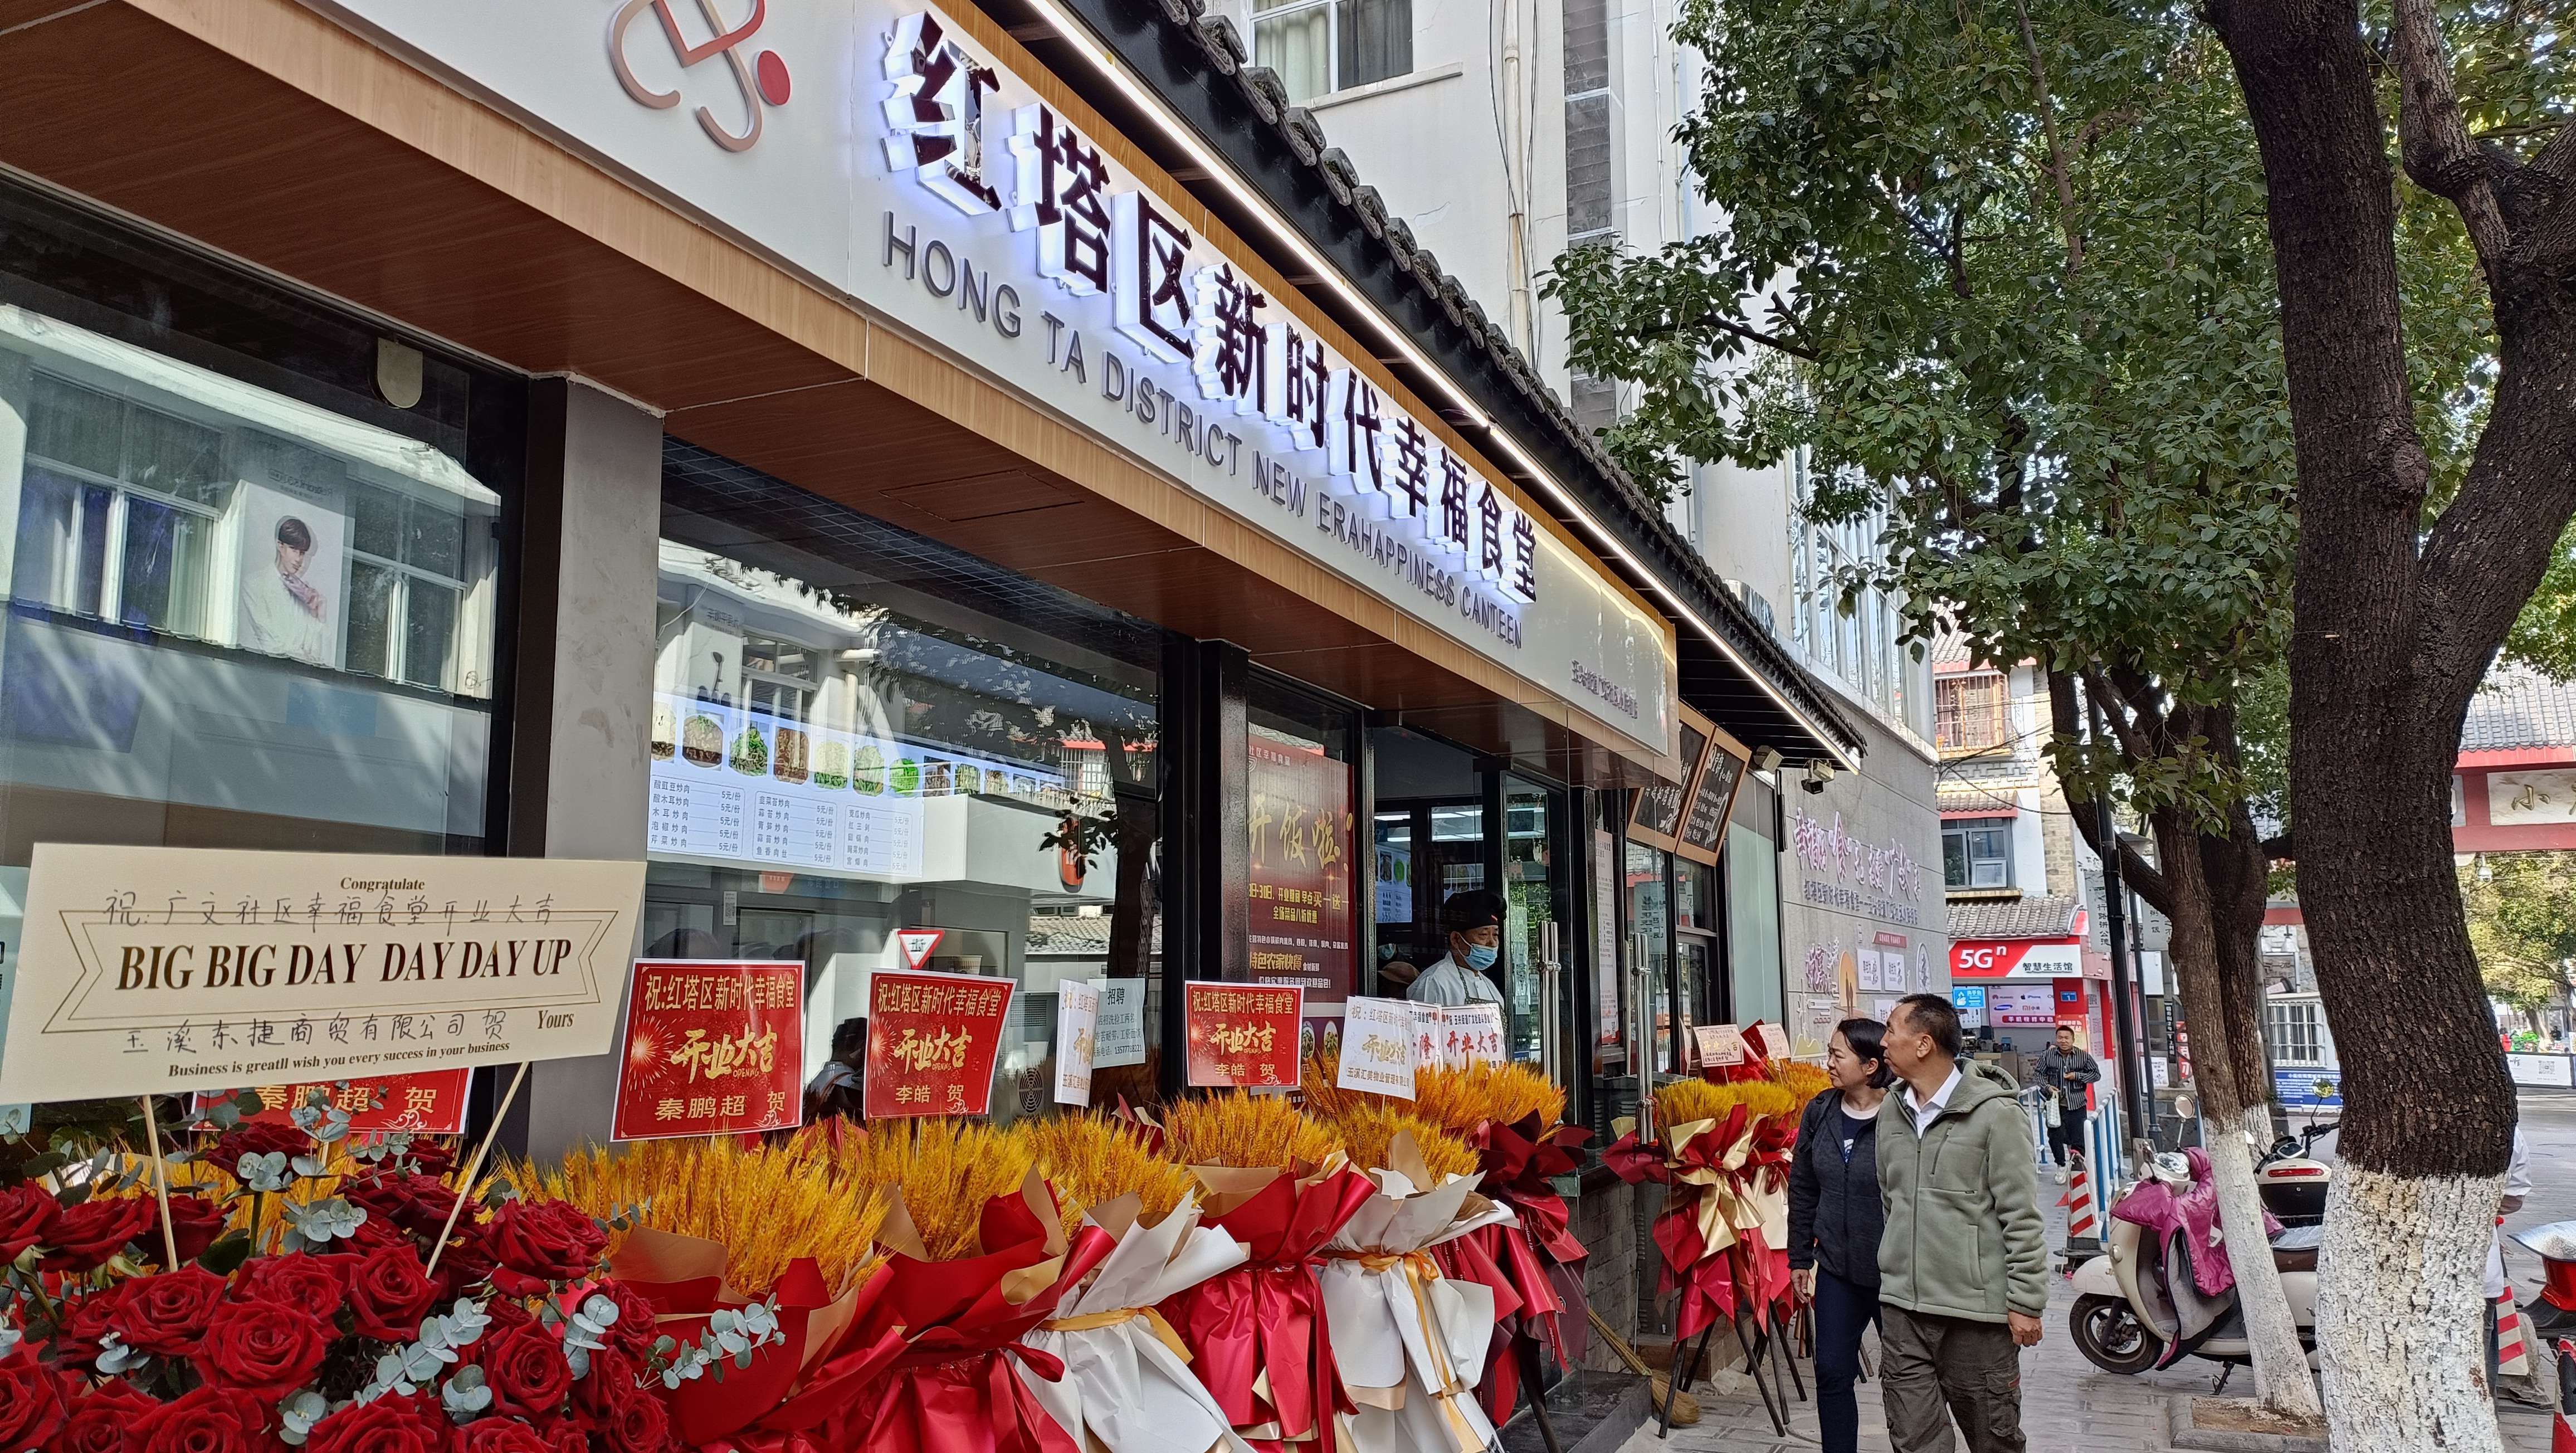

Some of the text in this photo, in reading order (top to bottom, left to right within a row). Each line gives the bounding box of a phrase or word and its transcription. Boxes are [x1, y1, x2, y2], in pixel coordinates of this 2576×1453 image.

[883, 8, 1536, 603] 红塔区新时代幸福食堂
[883, 210, 1523, 650] HONG TA DISTRICT NEW ERAHAPPINESS CANTEEN
[654, 780, 740, 801] 酸豇豆炒肉 5元/份
[653, 793, 740, 813] 酸木耳炒肉 5元/份
[817, 806, 833, 815] 5元/份
[652, 807, 739, 827] 木耳炒肉 5元/份
[816, 818, 833, 827] 5元/份
[652, 821, 738, 839] 泡椒炒肉 5元/份
[815, 830, 832, 839] 5元/份
[651, 835, 738, 852] 芹菜炒肉 5元/份
[814, 842, 831, 851] 5元/份
[756, 847, 831, 863] 鱼香肉丝 5元/份
[340, 877, 425, 891] Congratulate
[115, 939, 572, 990] BIG BIG DAY DAY DAY UP
[2023, 962, 2073, 972] 智慧生活馆
[1108, 987, 1125, 1006] 招聘
[482, 1009, 506, 1040] 贺
[538, 1010, 575, 1030] Yours
[1210, 1020, 1276, 1056] 开业大吉
[1447, 1030, 1497, 1057] 开业大吉
[168, 1062, 228, 1077] Business
[232, 1061, 242, 1073] is
[292, 1055, 320, 1069] wish
[324, 1056, 345, 1070] you
[349, 1053, 381, 1065] every
[383, 1049, 423, 1062] success
[426, 1045, 437, 1057] in
[440, 1046, 466, 1059] your
[468, 1041, 510, 1055] business
[670, 1020, 778, 1084] 开业大吉
[894, 1025, 973, 1074] 开业大吉
[733, 1067, 760, 1079] OPENING
[1215, 1063, 1275, 1077] 李皓 贺
[406, 1086, 436, 1114] 贺
[895, 1084, 964, 1104] 李皓 贺
[655, 1090, 786, 1121] 秦鹏超 贺
